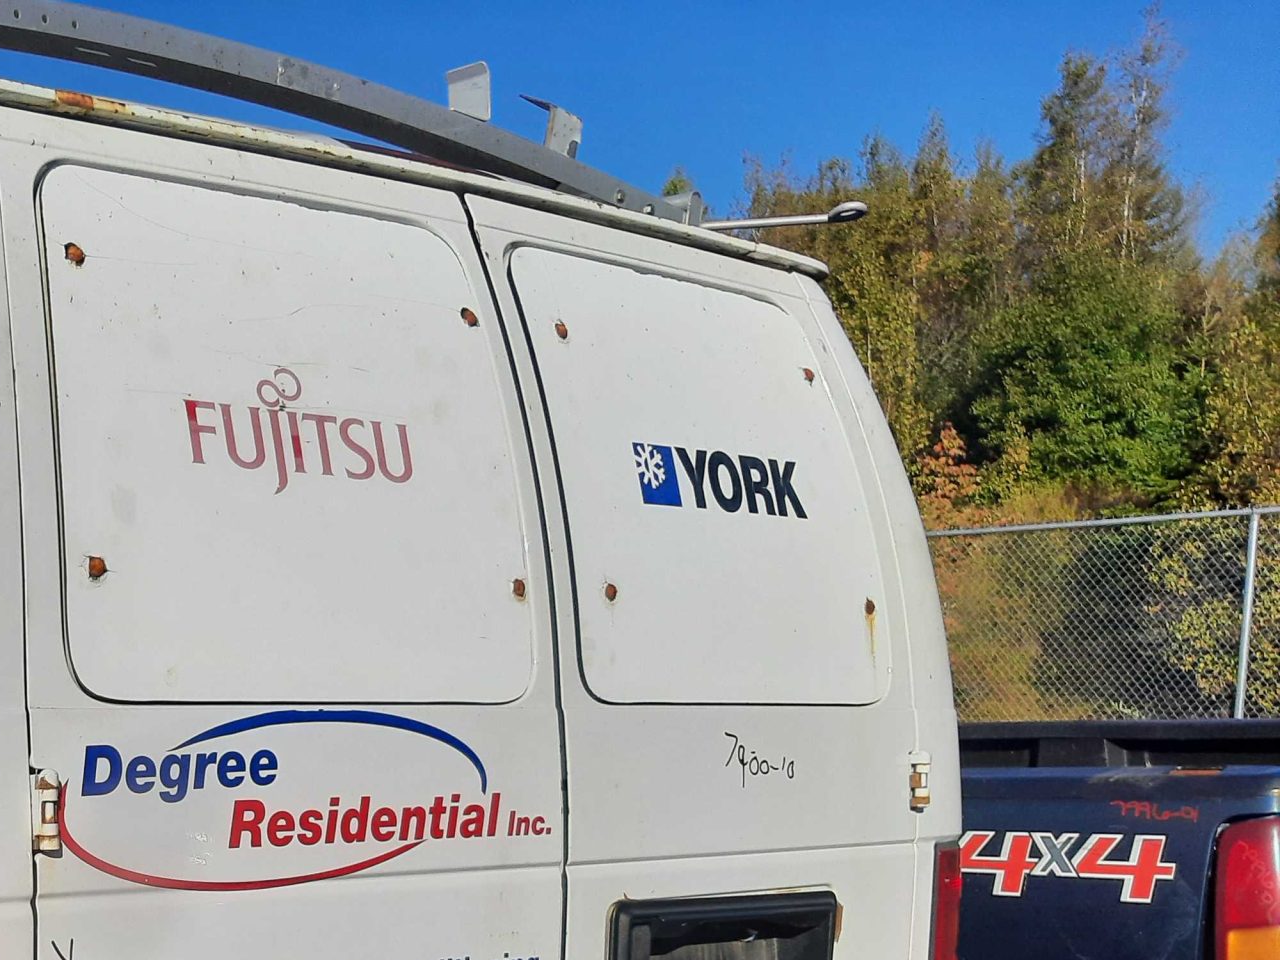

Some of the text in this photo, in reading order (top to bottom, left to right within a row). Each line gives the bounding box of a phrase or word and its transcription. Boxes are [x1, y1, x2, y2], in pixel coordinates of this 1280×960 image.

[182, 399, 413, 495] FUJITSU
[673, 446, 808, 519] YORK
[81, 744, 279, 803] Degree
[228, 792, 552, 849] Residential Inc.
